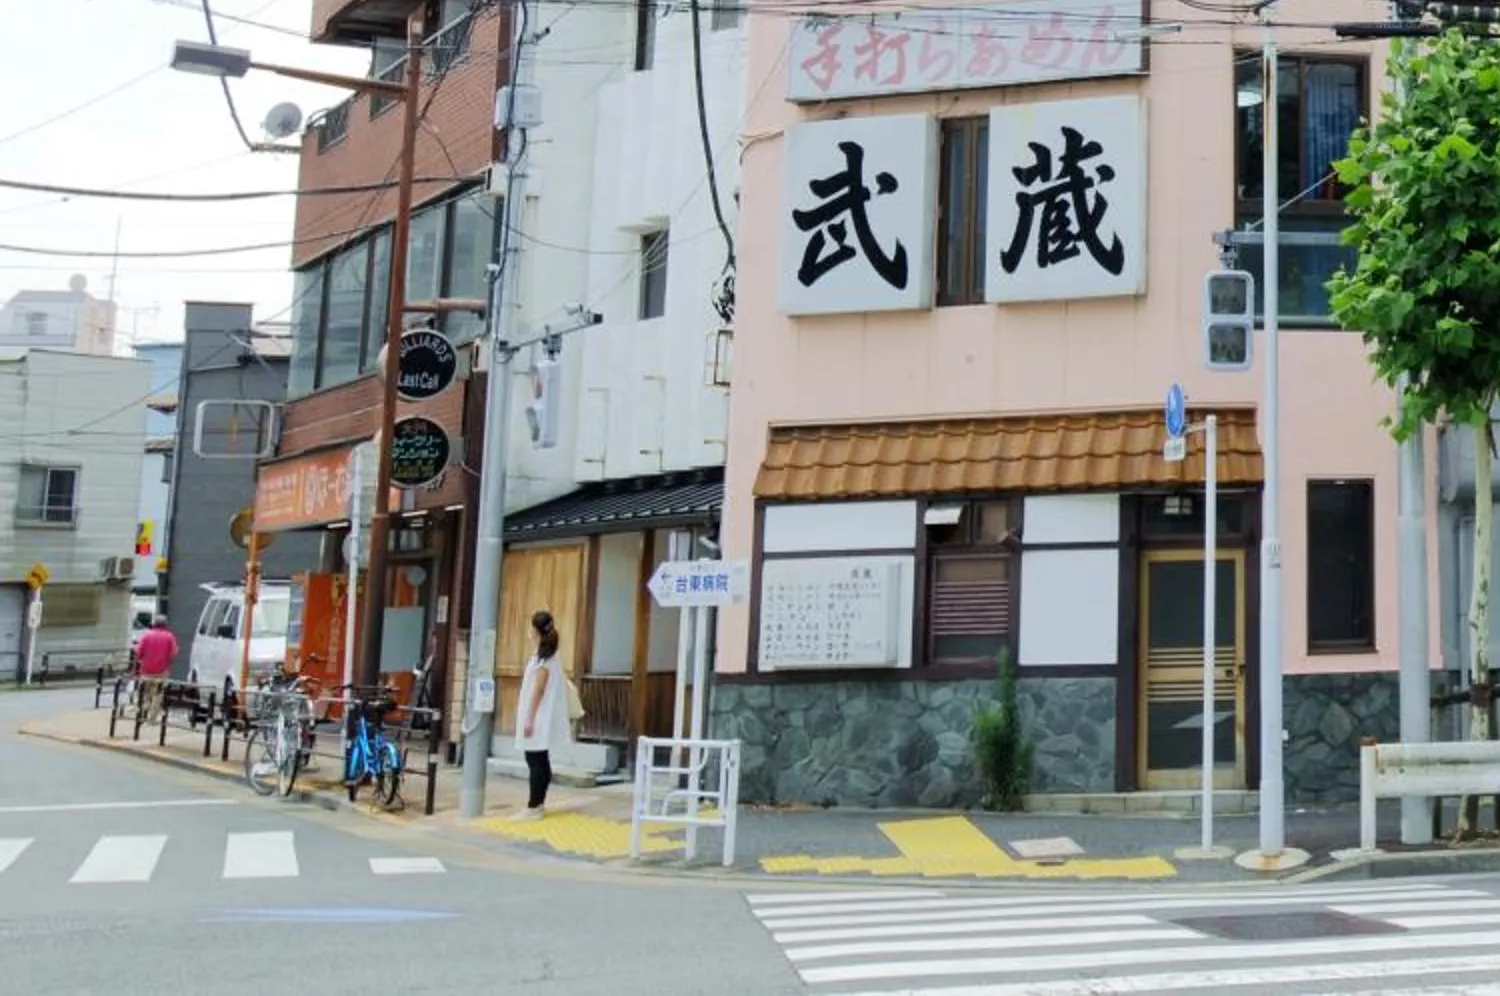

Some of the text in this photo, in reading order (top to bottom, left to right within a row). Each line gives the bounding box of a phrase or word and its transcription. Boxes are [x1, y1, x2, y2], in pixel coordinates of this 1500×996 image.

[801, 5, 1128, 92] 手打らあめん
[792, 125, 1125, 290] 武蔵
[399, 334, 450, 363] ILLIARDS
